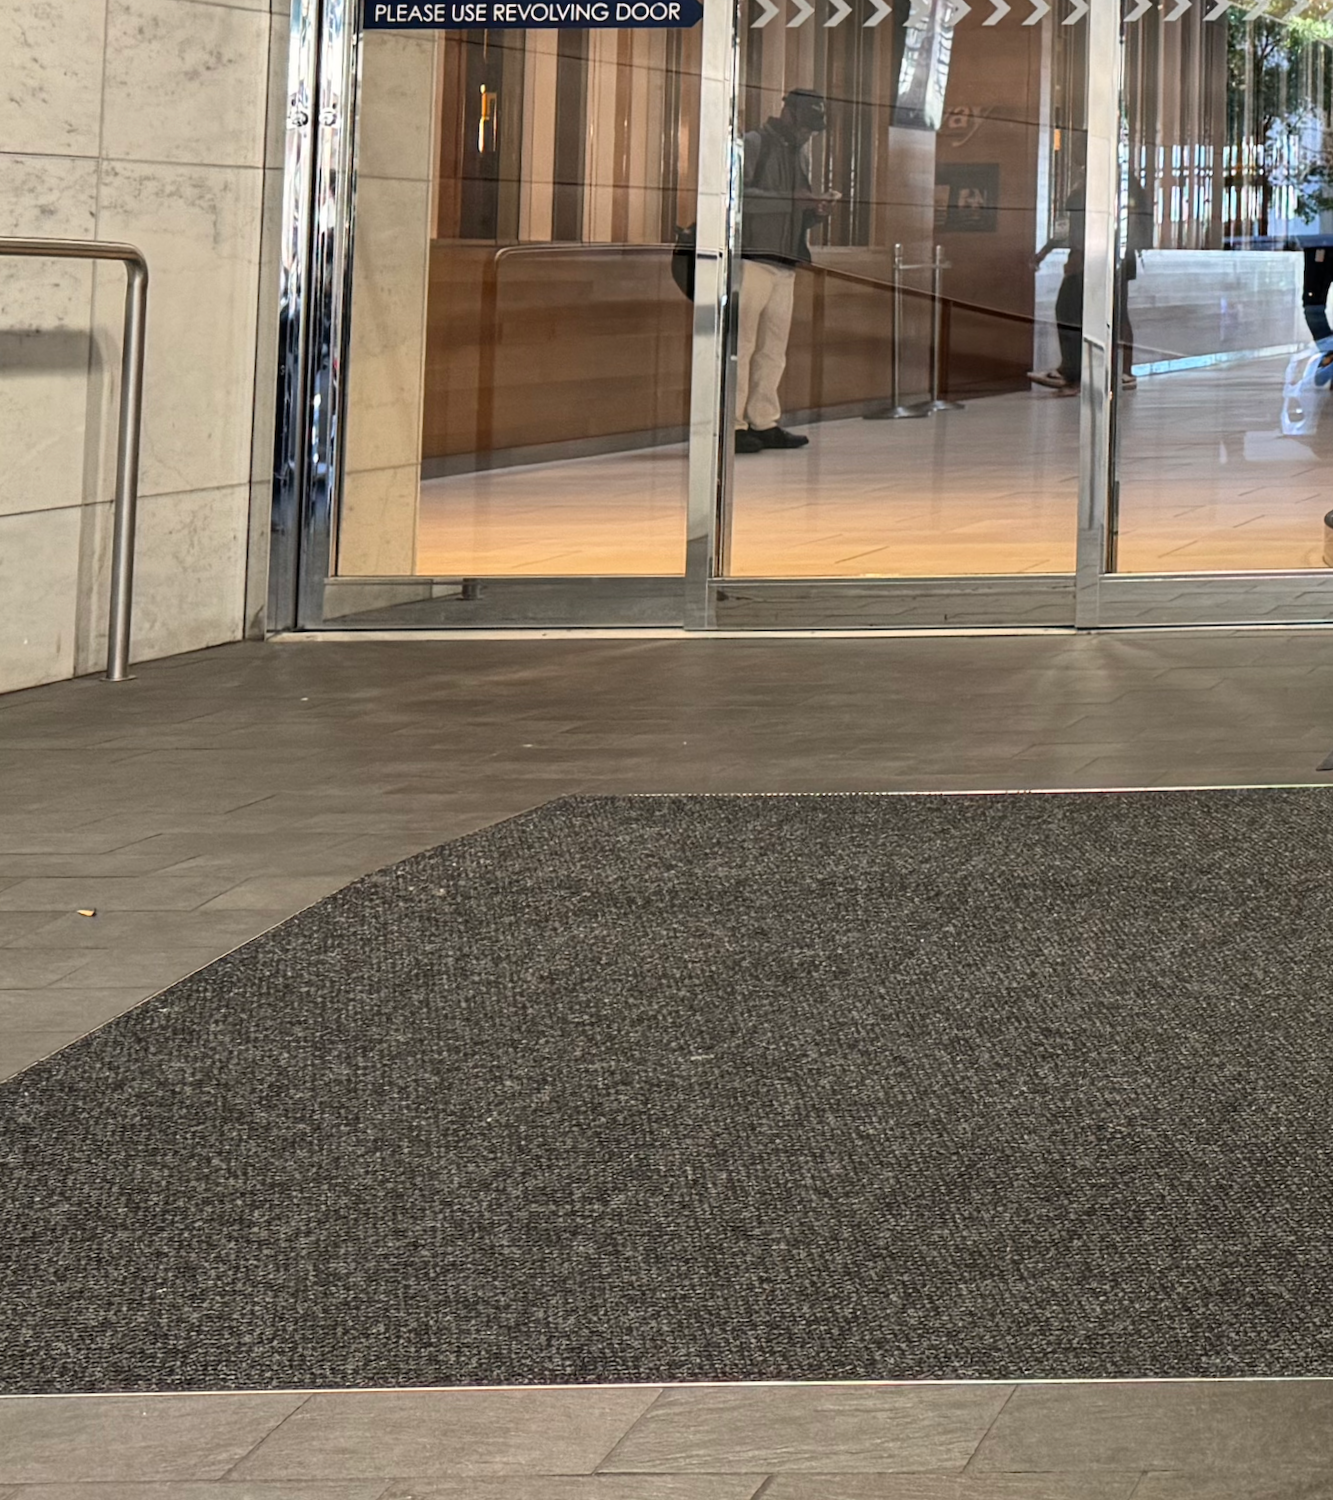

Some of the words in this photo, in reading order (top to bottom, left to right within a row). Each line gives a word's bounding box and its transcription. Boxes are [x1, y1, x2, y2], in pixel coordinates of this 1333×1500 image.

[374, 3, 446, 23] PLEASE
[451, 3, 487, 23] USE
[493, 2, 609, 22] REVOLVING
[615, 2, 681, 21] DOOR
